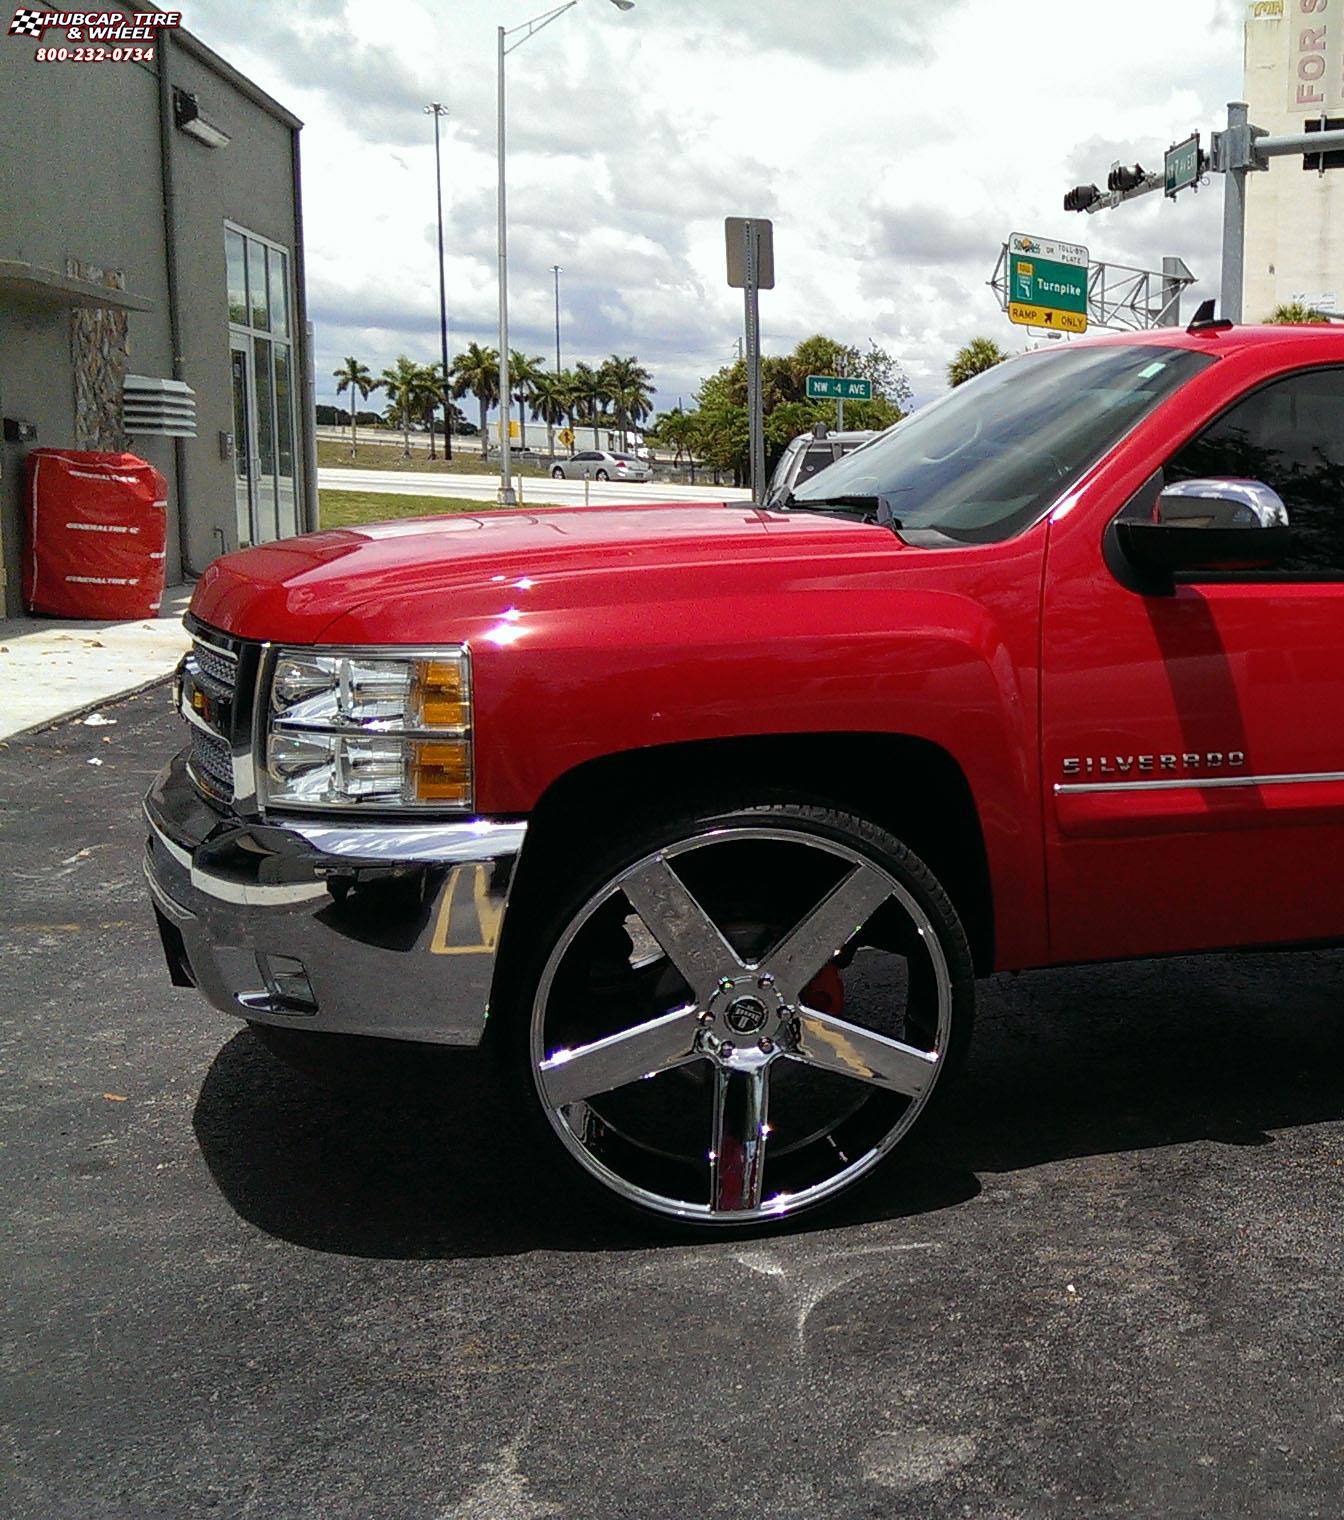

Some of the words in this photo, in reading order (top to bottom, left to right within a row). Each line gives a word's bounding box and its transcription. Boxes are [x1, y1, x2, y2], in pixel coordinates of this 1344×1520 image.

[1296, 25, 1327, 104] FOR
[1061, 254, 1081, 264] PLATE
[1037, 278, 1081, 296] Turnpike
[1012, 308, 1038, 320] RAMP
[1061, 316, 1084, 327] ONLY
[813, 382, 828, 392] NW
[833, 383, 841, 393] 4
[848, 383, 866, 395] AVE
[1062, 751, 1245, 774] SILVERADO
